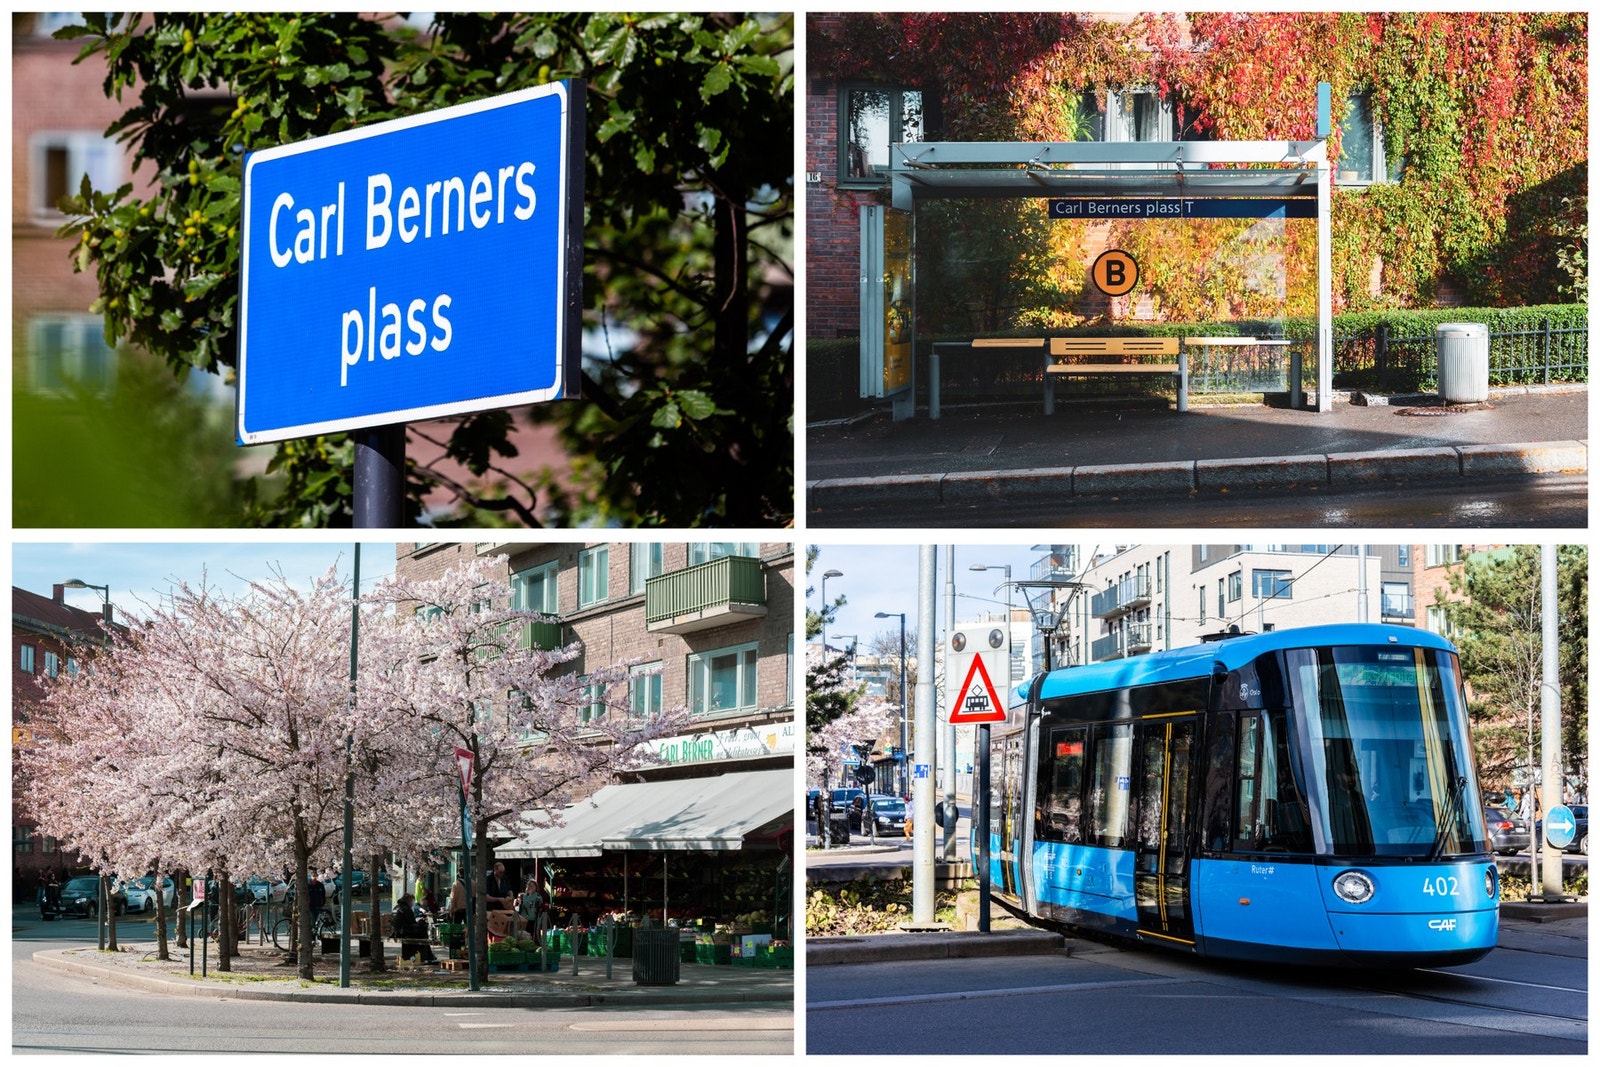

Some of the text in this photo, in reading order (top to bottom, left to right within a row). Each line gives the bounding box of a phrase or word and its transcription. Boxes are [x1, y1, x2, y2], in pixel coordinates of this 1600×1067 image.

[269, 161, 537, 268] Carl Berners
[1056, 201, 1195, 216] Carl Berners plass T
[1106, 259, 1126, 286] B
[340, 286, 453, 387] plass
[659, 739, 713, 764] CARL BERNER
[1251, 864, 1275, 874] Ruter#
[1423, 876, 1460, 896] 402
[1428, 918, 1457, 932] CAF
